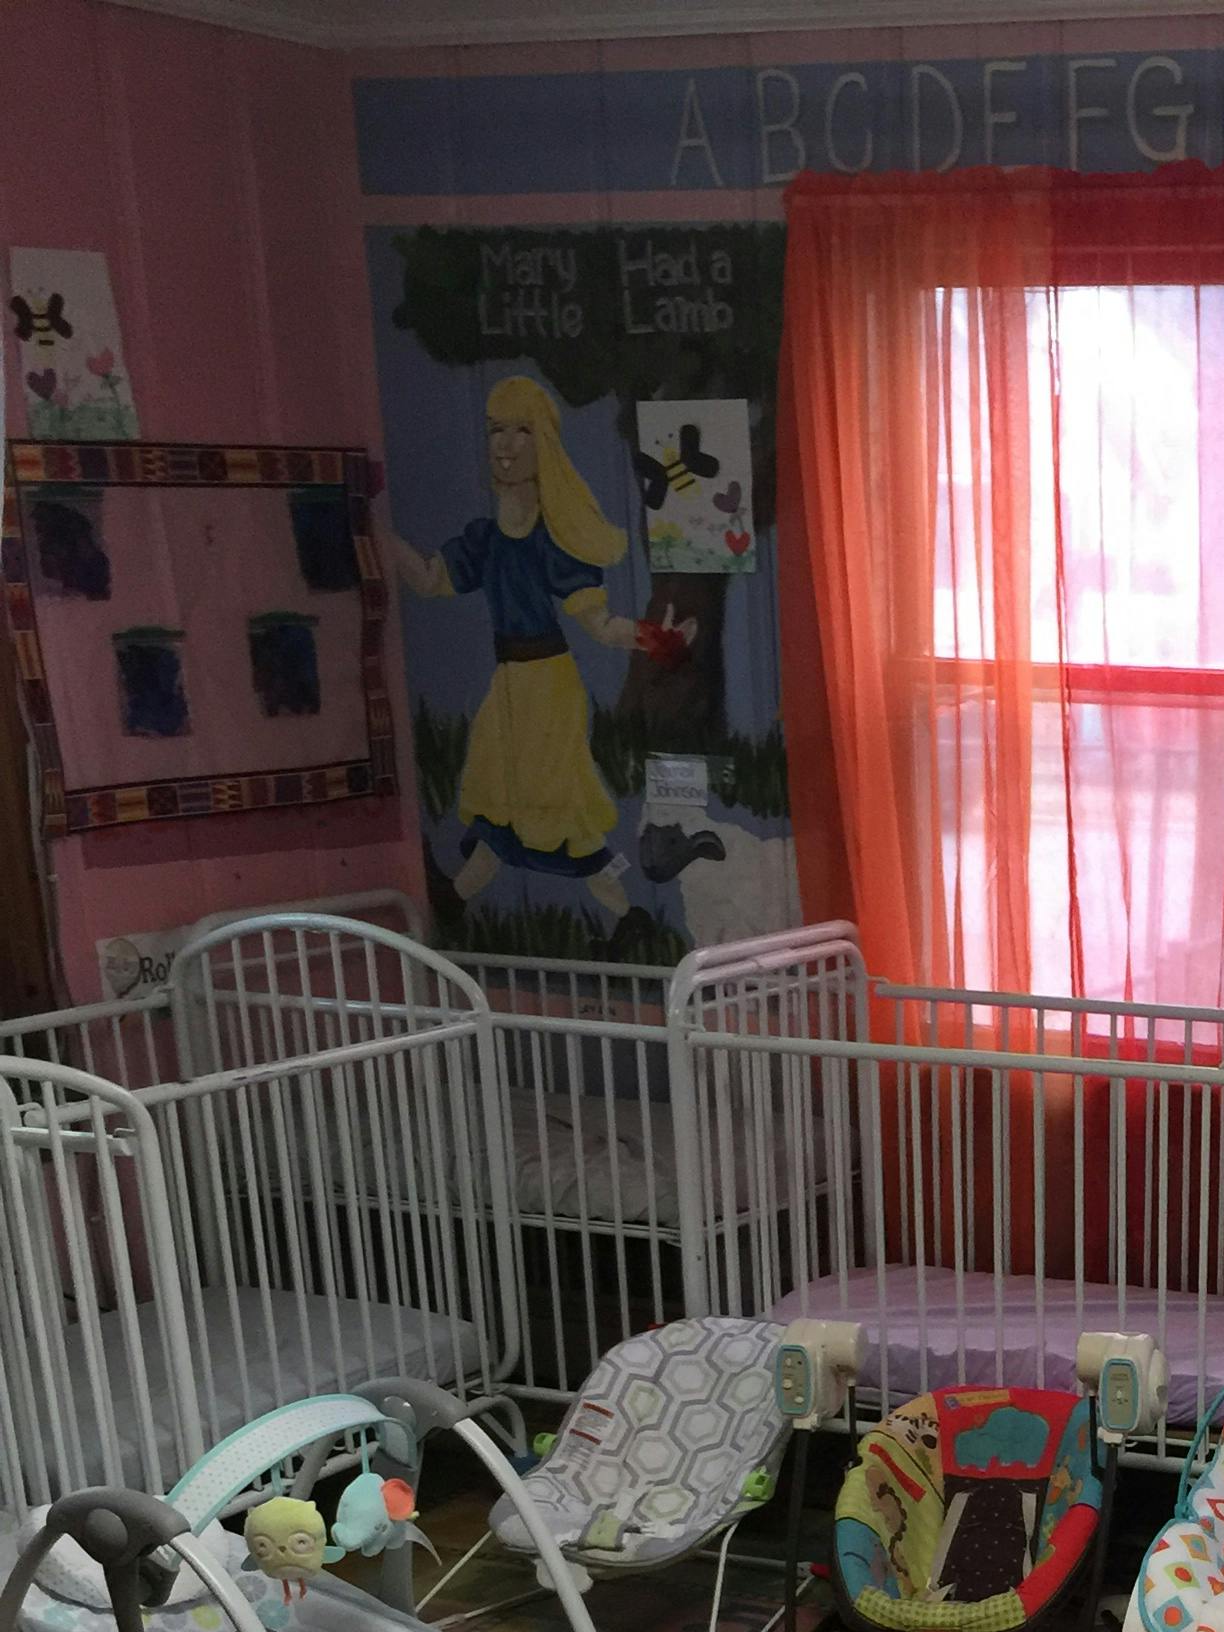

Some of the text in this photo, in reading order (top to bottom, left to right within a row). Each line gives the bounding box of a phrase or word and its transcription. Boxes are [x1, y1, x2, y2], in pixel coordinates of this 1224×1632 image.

[670, 78, 726, 188] A
[756, 68, 802, 184] B
[824, 72, 873, 175] C
[911, 64, 965, 175] D
[1068, 58, 1117, 170] F
[1127, 57, 1195, 163] G
[481, 239, 734, 294] Mary Had a
[479, 287, 735, 338] Little Lamb
[139, 951, 176, 984] Rol
